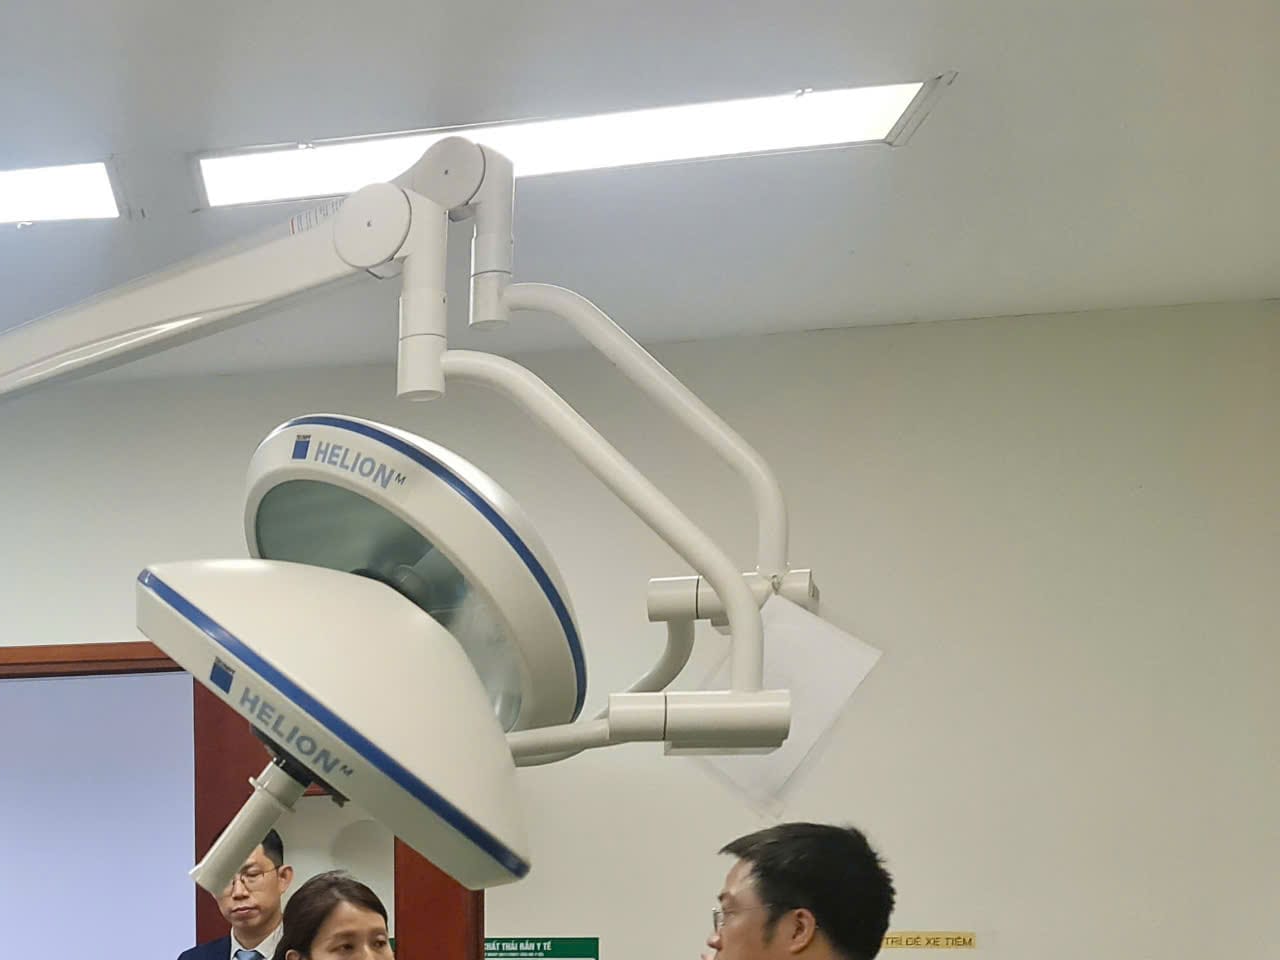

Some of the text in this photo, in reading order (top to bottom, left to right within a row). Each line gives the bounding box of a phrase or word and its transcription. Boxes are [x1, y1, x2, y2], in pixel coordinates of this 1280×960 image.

[314, 441, 395, 489] HELION
[240, 687, 339, 774] HELION
[924, 936, 941, 946] XE
